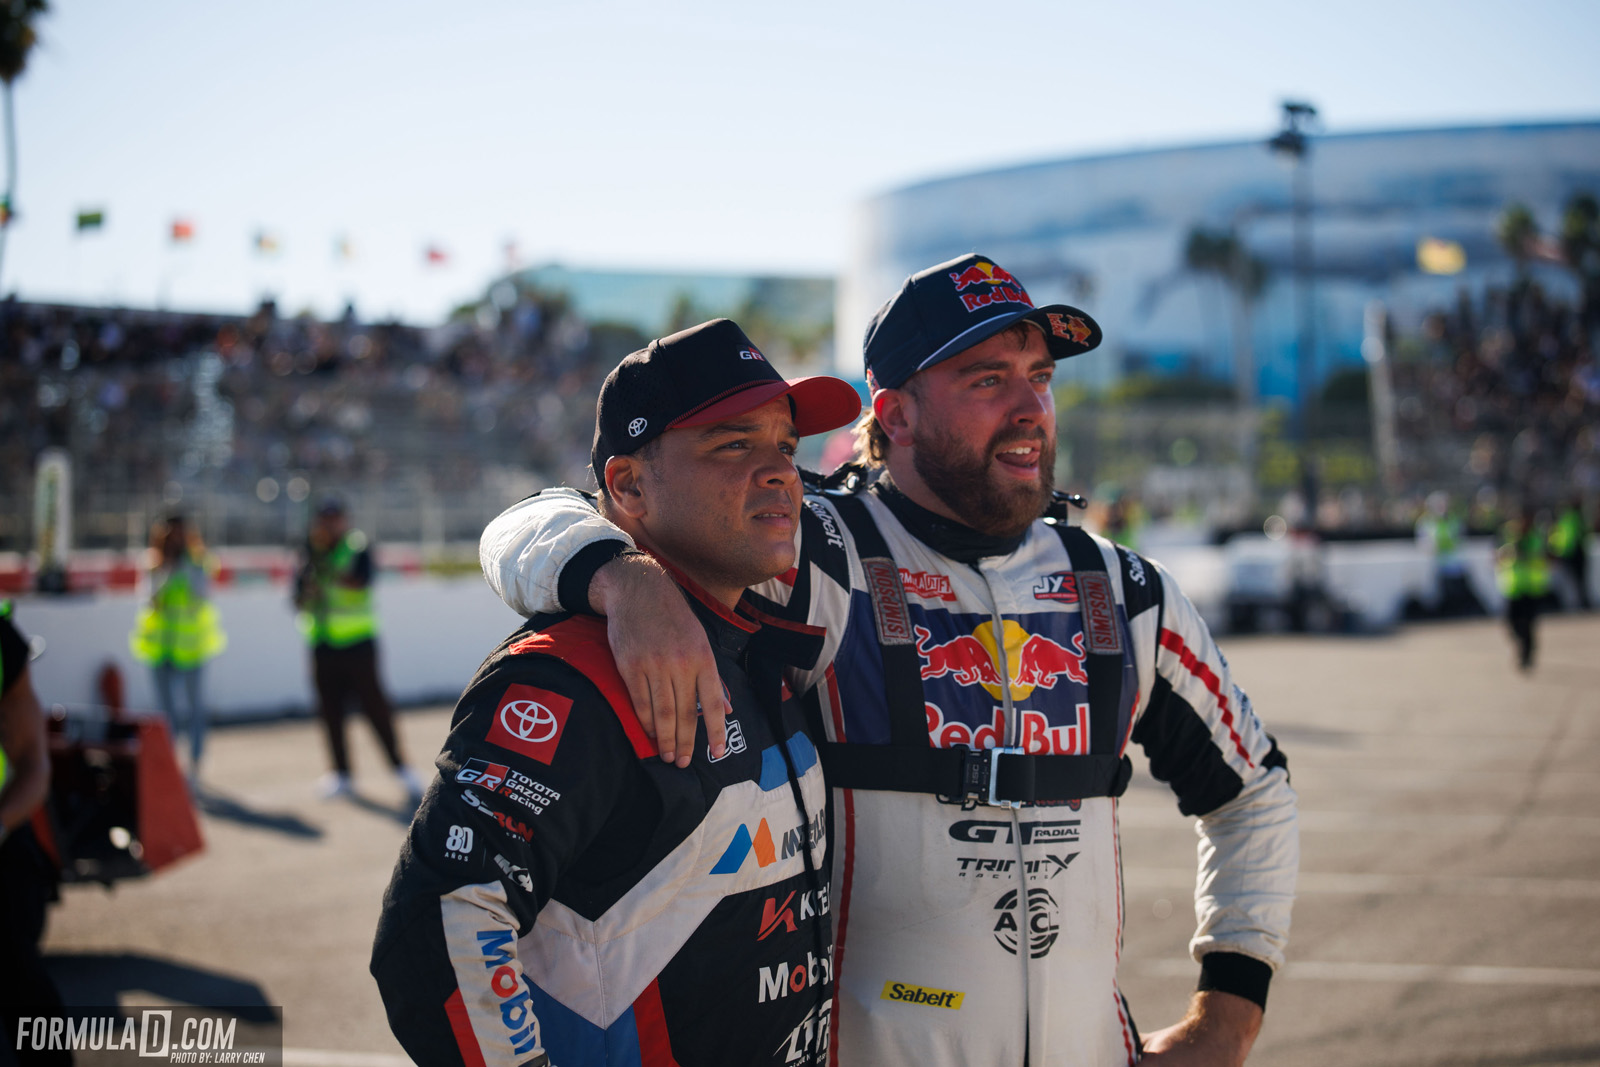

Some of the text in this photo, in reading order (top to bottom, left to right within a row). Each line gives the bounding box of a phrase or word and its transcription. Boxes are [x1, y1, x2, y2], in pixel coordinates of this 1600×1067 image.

[739, 350, 765, 361] GR
[873, 567, 904, 634] SIMPSON
[1087, 581, 1113, 646] SIMPSON
[457, 769, 561, 801] GR TOYOTA
[505, 779, 551, 806] GAZOO
[499, 786, 544, 815] Racing
[446, 825, 473, 854] 80
[948, 820, 1080, 845] GT RADIAL
[477, 929, 536, 1055] Mobil
[889, 983, 956, 1007] Sabelt
